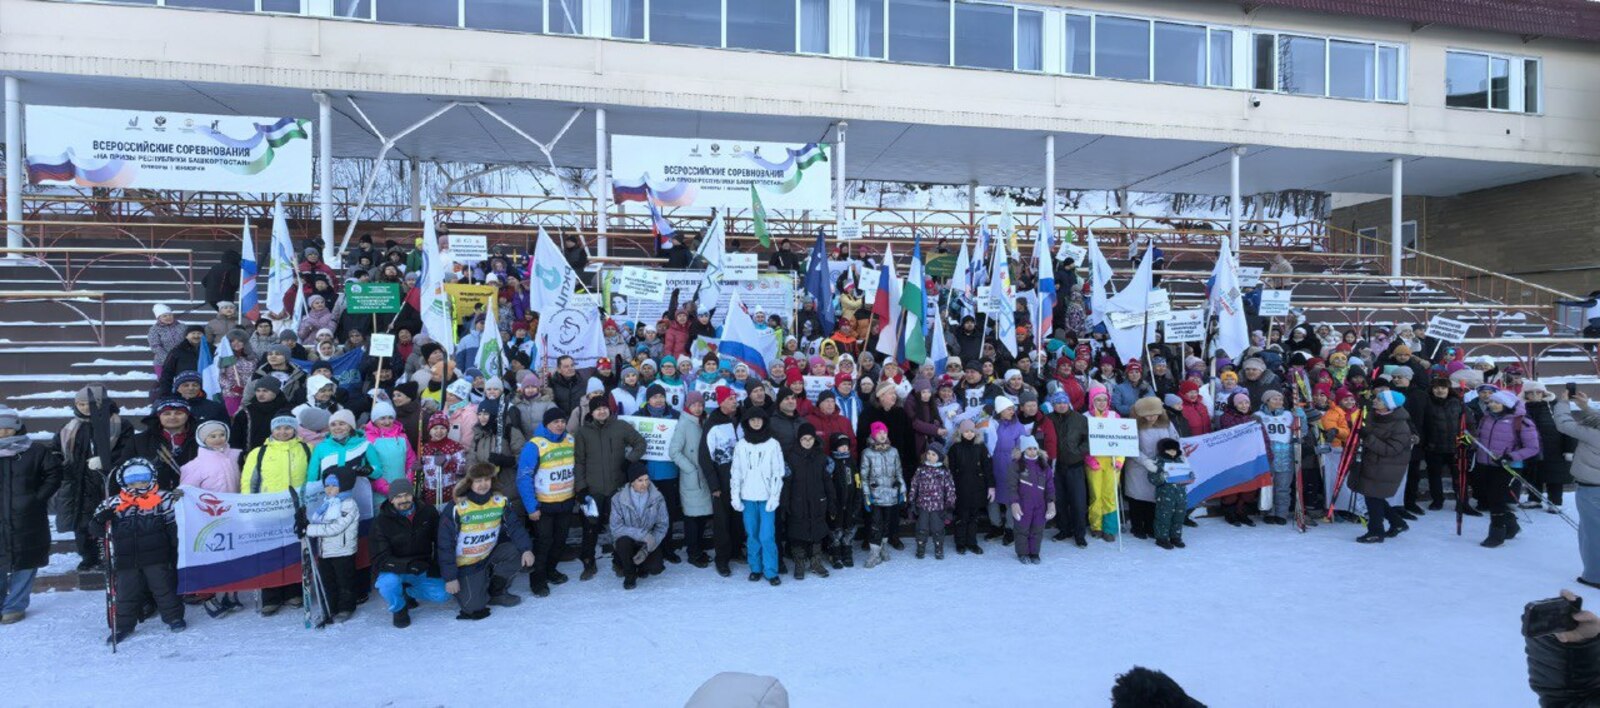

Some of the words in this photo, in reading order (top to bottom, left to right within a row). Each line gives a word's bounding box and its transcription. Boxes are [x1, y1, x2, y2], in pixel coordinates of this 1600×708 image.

[93, 140, 174, 154] ВСЕРОССИЙСКИЕ
[176, 145, 251, 157] СОРЕВНОВАНИЯ
[664, 165, 725, 177] ВСЕРОССИЙСКИЕ
[727, 168, 784, 178] СОРЕВНОВАНИЯ
[1268, 423, 1286, 434] 90
[550, 467, 575, 482] СУДЬ
